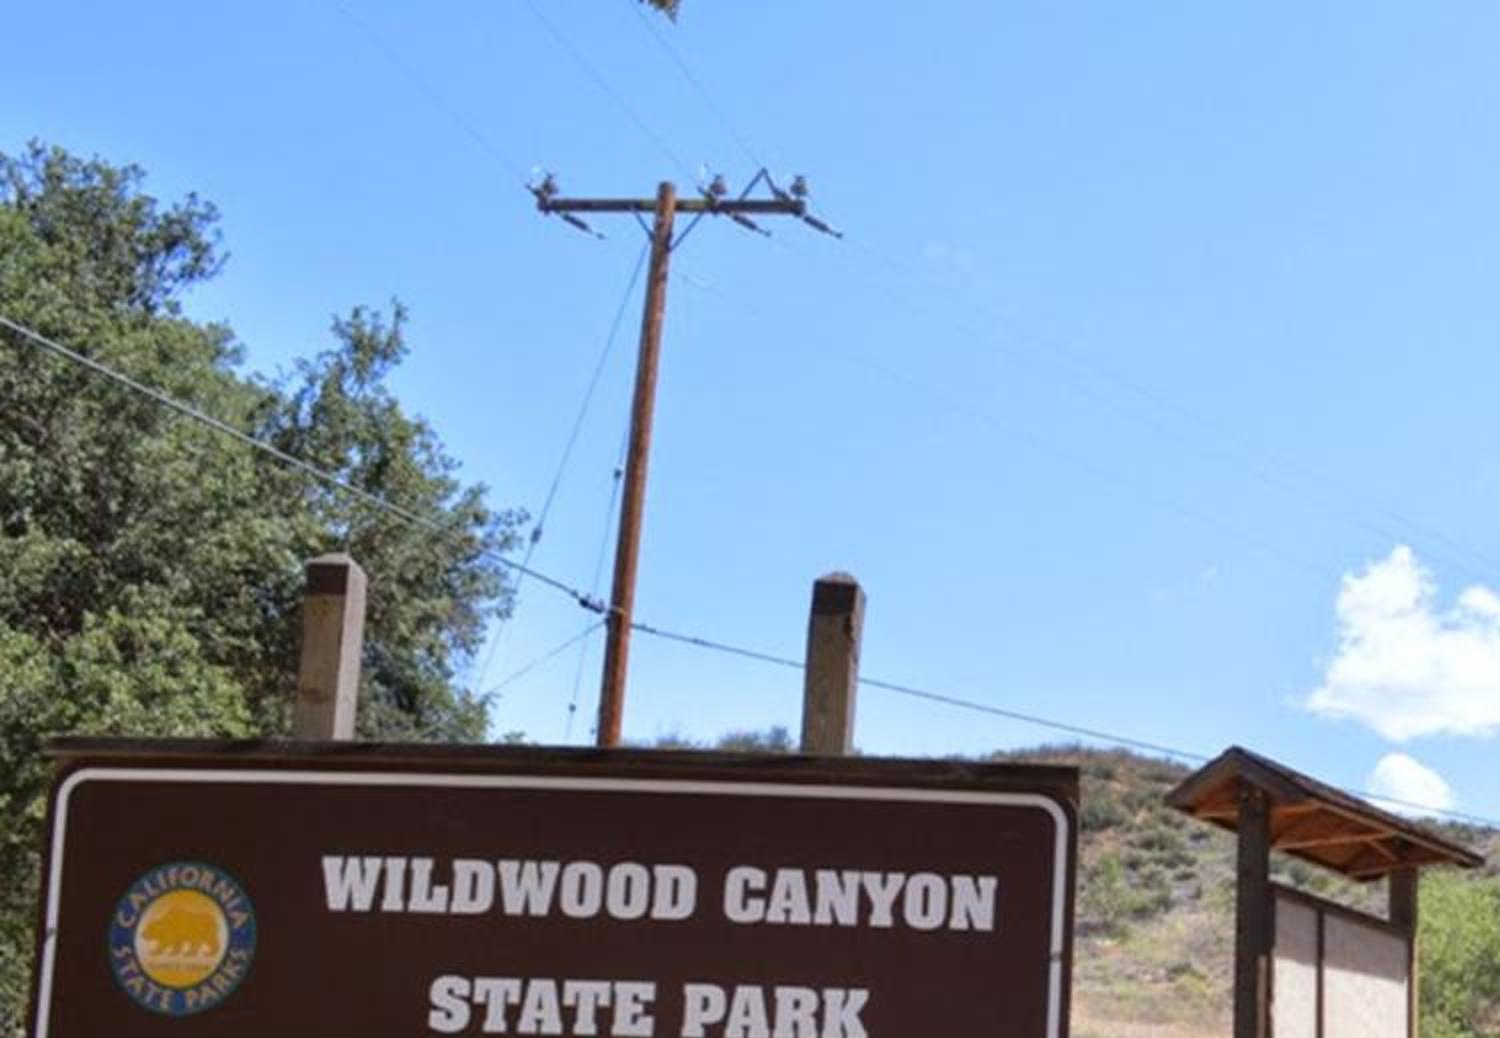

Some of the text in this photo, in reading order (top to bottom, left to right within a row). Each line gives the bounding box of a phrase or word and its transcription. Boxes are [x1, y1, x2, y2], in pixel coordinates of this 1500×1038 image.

[117, 866, 249, 928] CALIFORNIA
[321, 855, 998, 931] WILDWOOD CANYON
[113, 945, 248, 1011] STATE PARKS
[427, 974, 657, 1038] STATE
